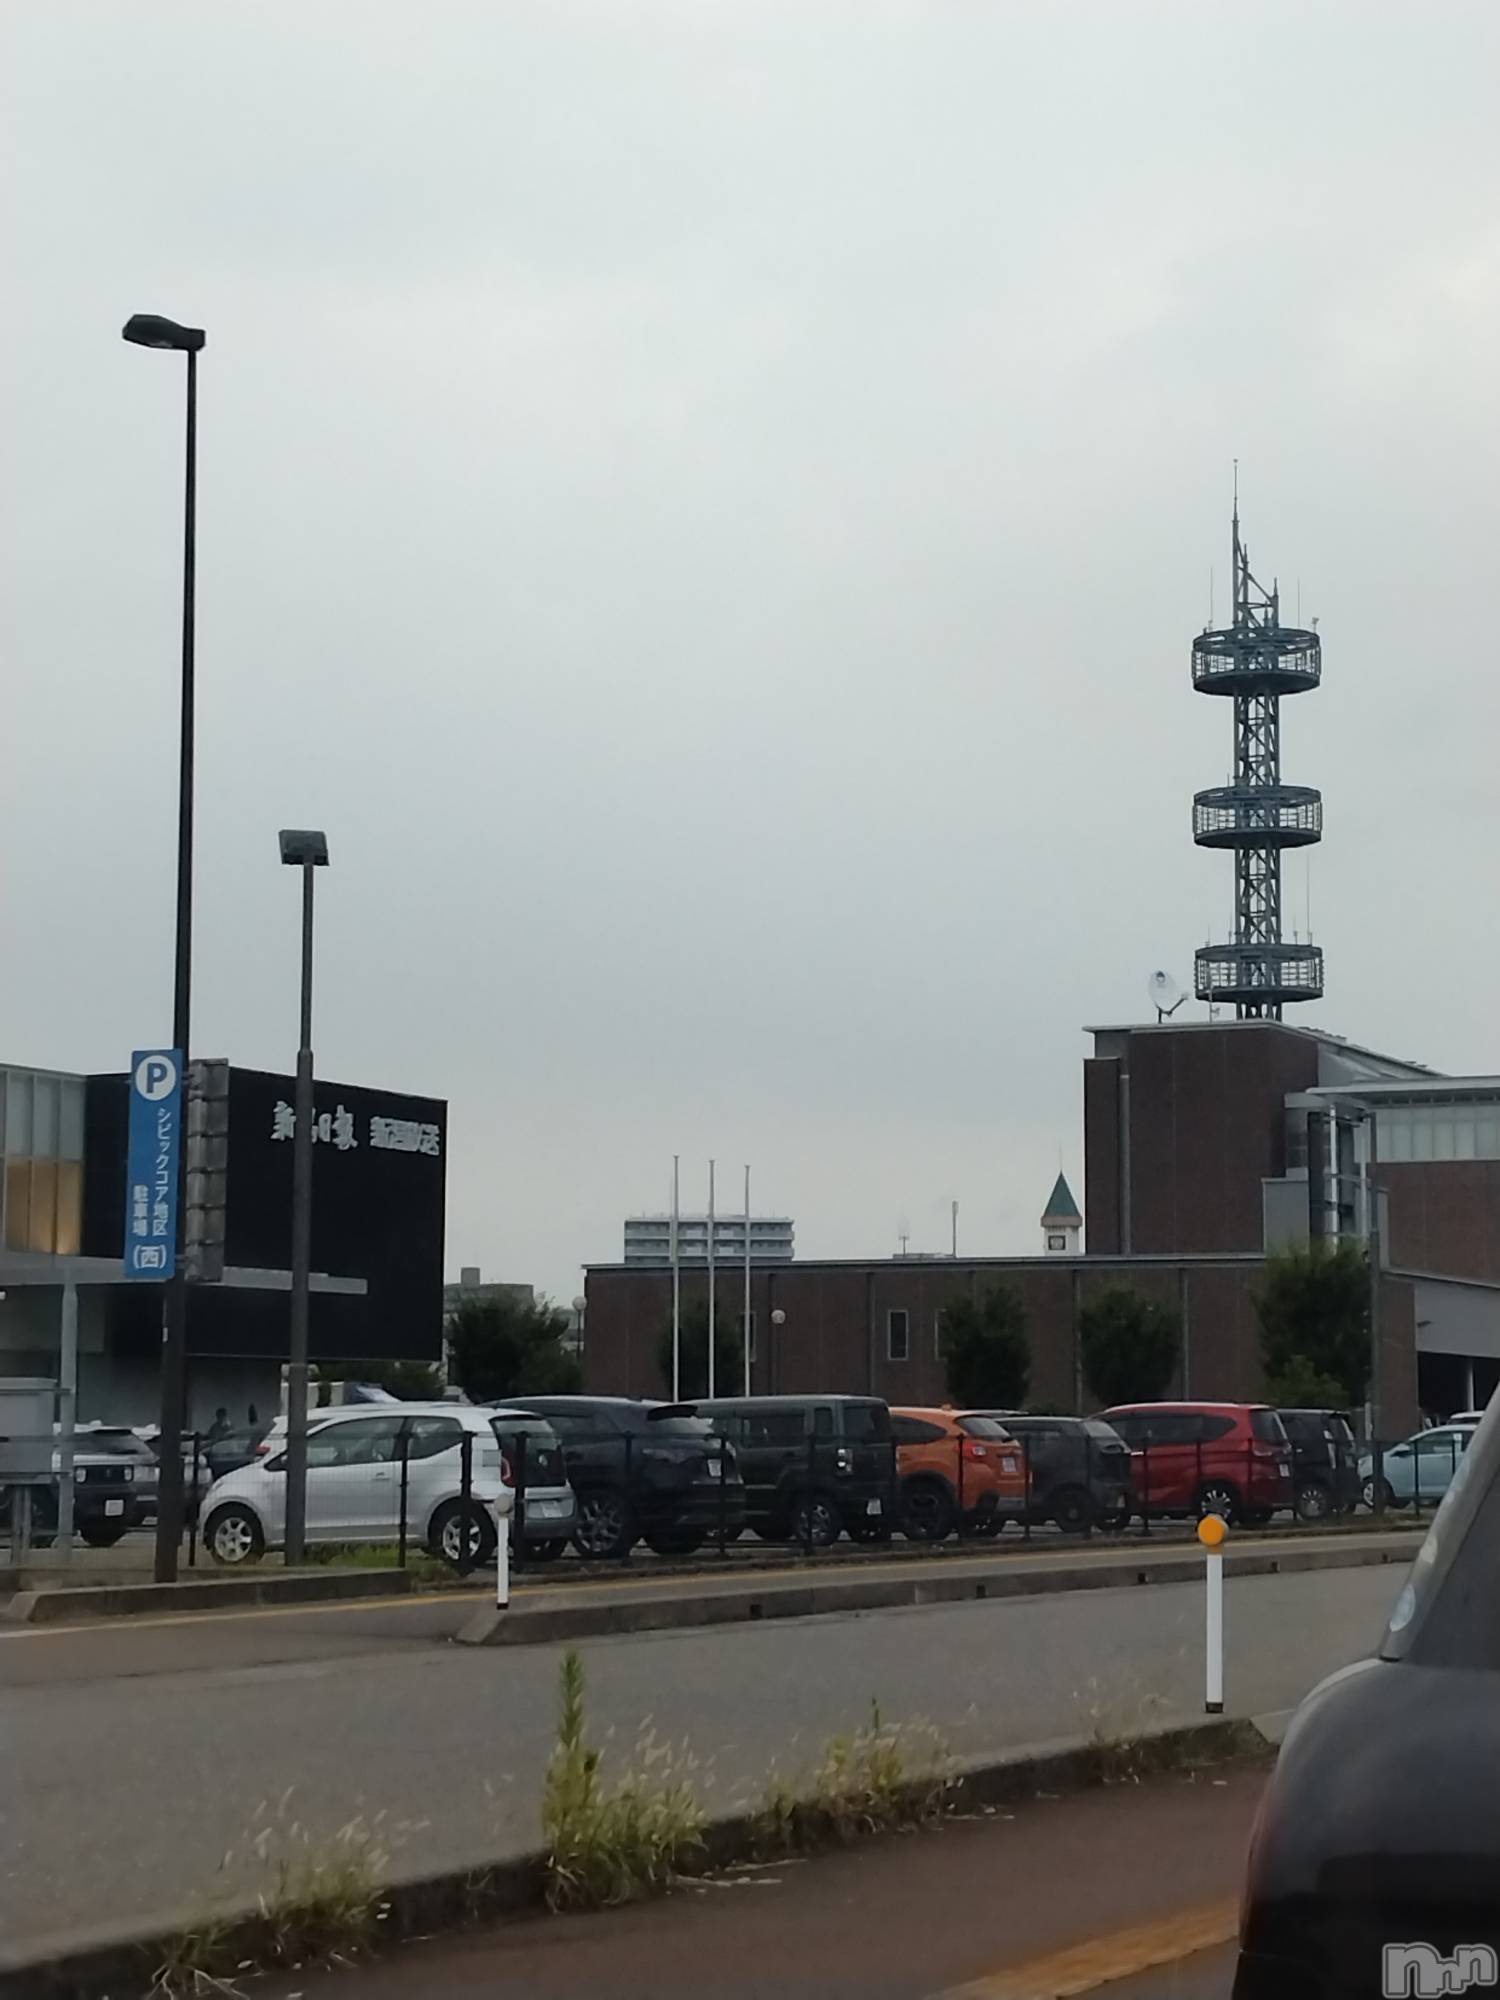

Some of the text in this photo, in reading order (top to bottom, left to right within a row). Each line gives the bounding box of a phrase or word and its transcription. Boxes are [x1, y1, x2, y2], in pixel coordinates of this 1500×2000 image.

[147, 1062, 168, 1093] P
[152, 1108, 173, 1236] シビックコア地区
[132, 1184, 149, 1237] 駐車場
